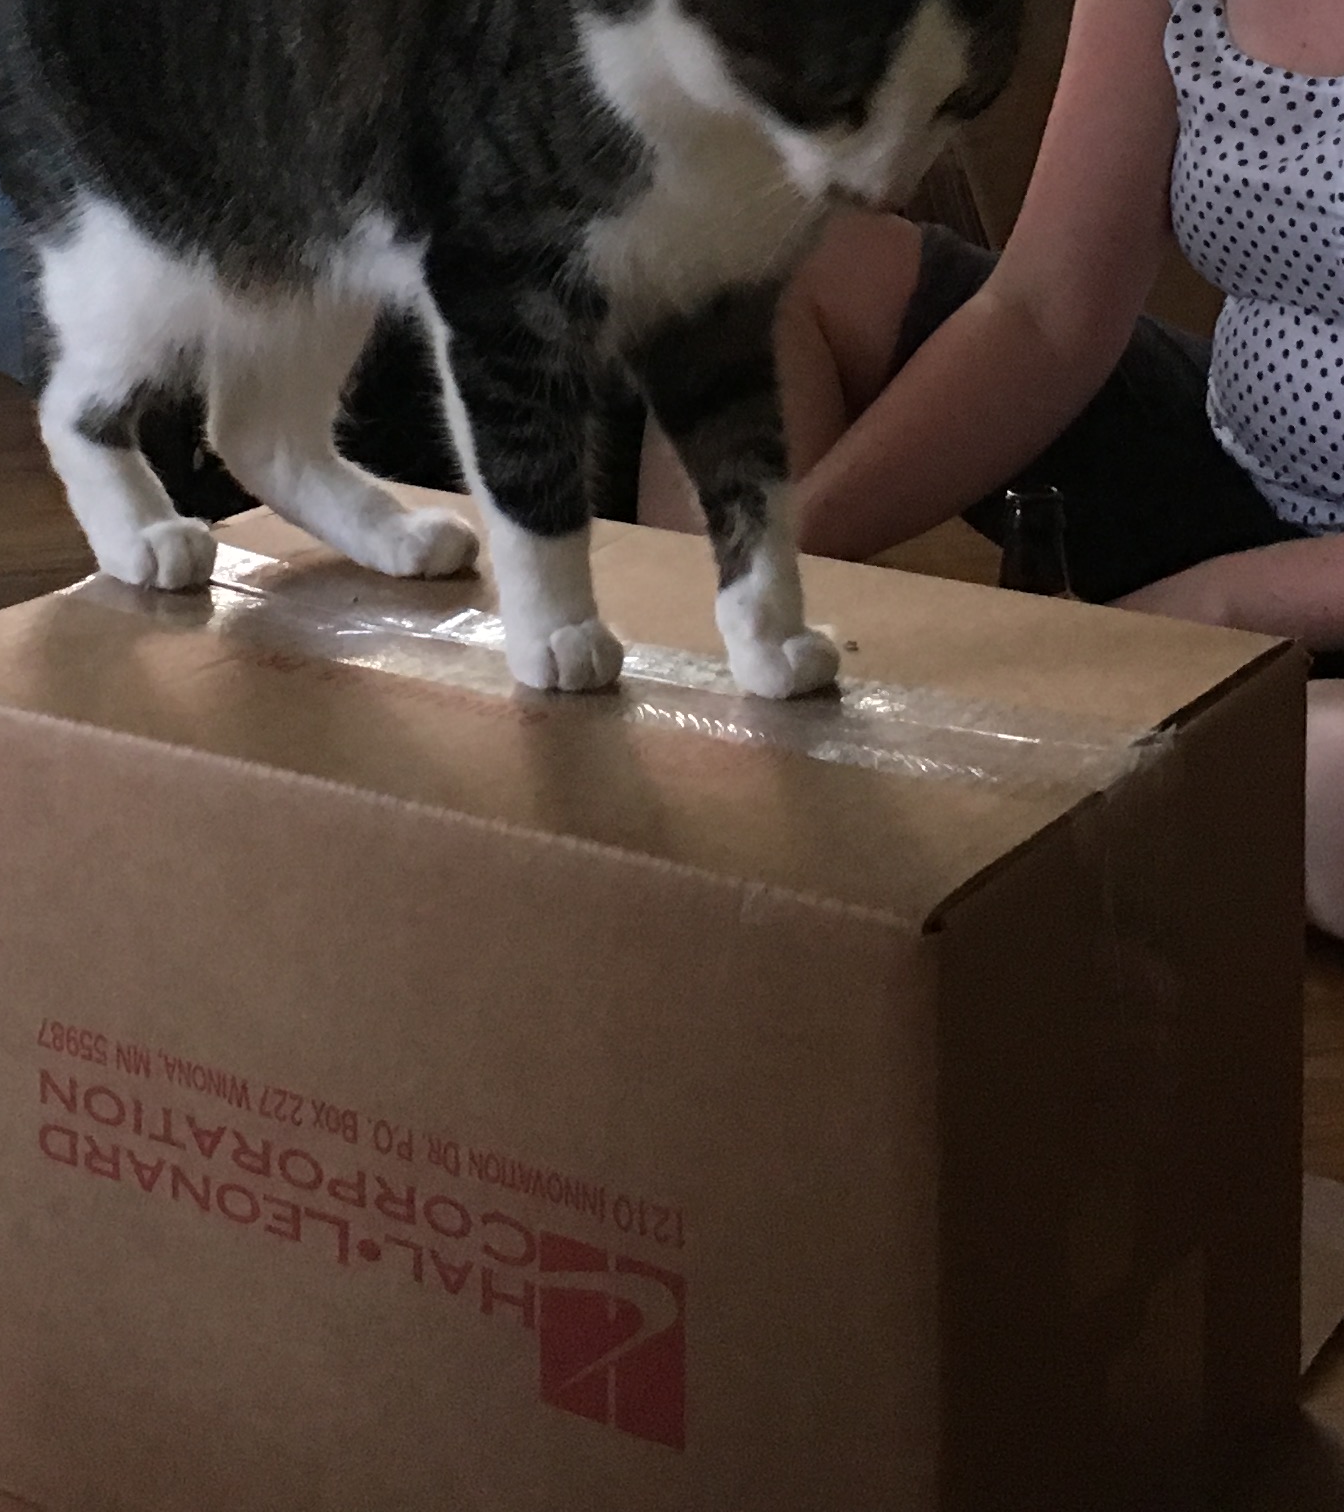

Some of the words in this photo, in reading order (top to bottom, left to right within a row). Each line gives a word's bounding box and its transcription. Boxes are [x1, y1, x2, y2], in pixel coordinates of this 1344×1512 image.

[37, 1018, 108, 1066] 55987
[115, 1043, 152, 1079] MN
[259, 1085, 309, 1127] 227
[311, 1099, 358, 1144] BOX
[39, 1068, 537, 1266] CORPORATION
[468, 1147, 606, 1223] INNOVATION
[613, 1194, 685, 1250] 1210
